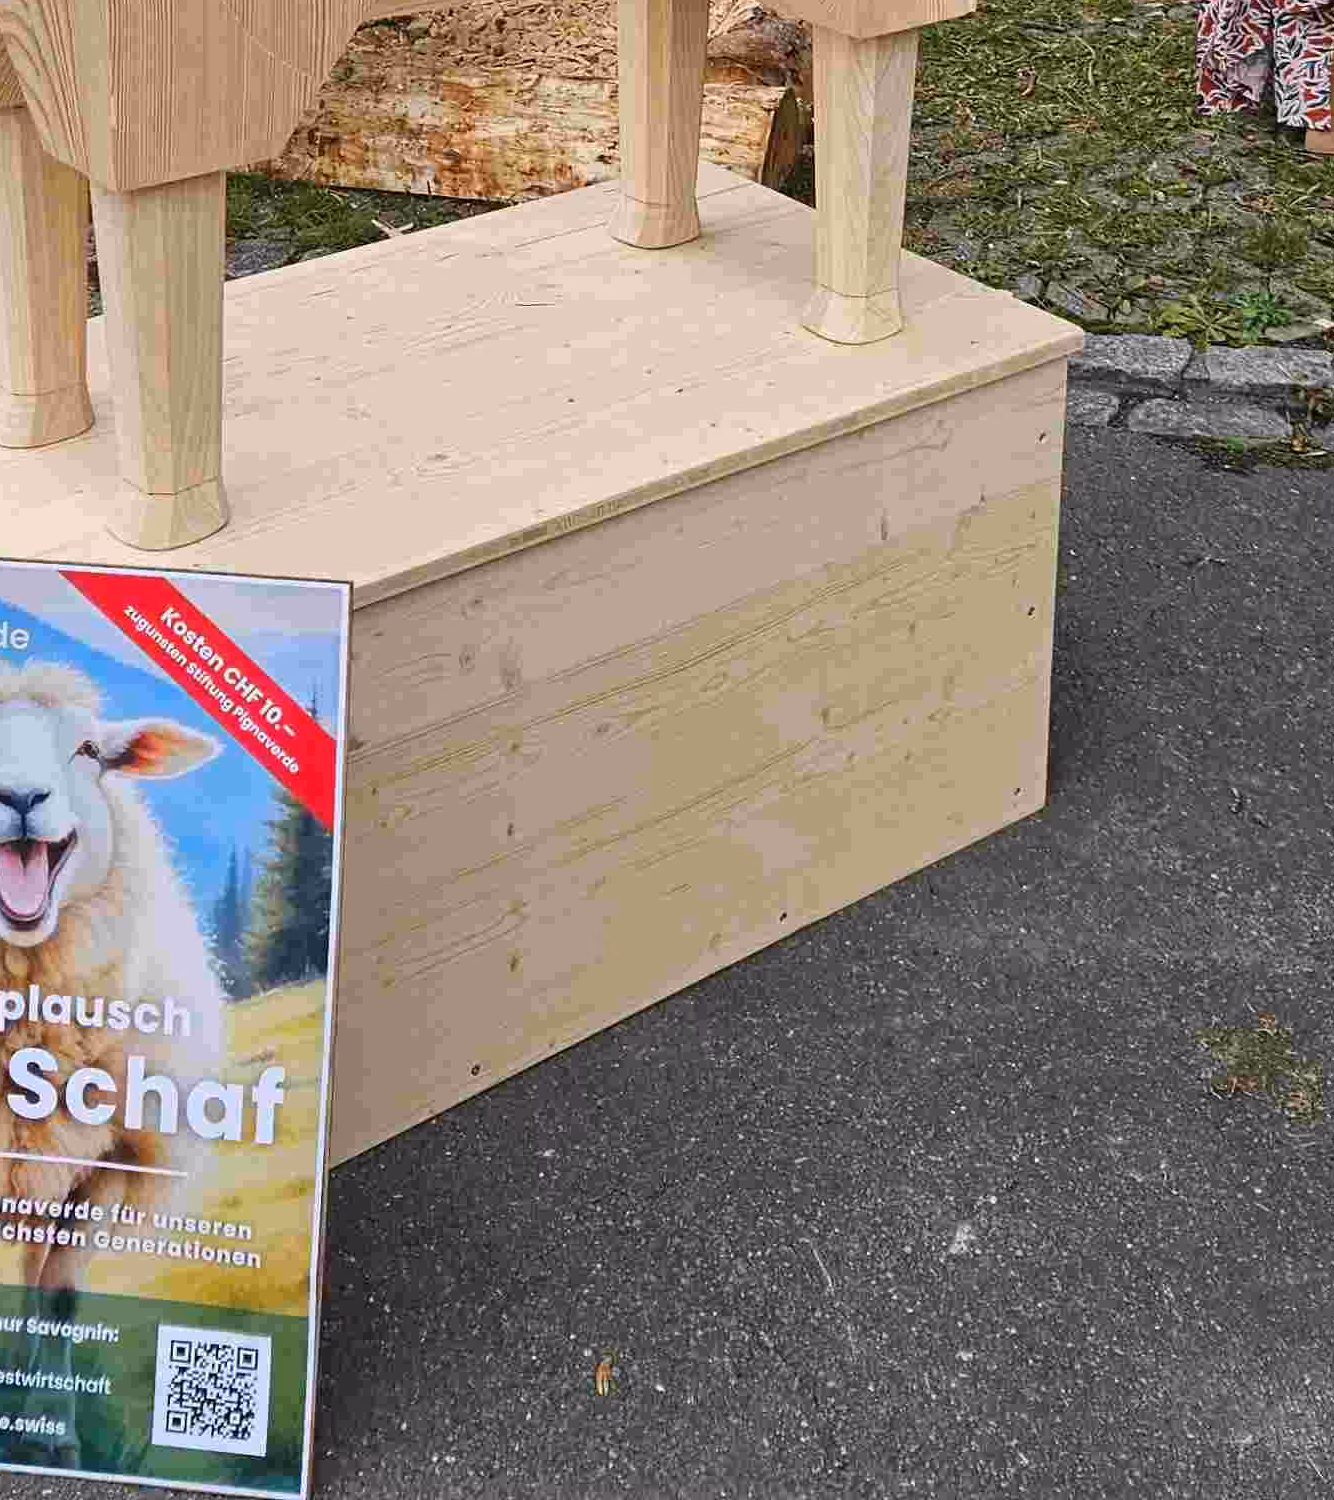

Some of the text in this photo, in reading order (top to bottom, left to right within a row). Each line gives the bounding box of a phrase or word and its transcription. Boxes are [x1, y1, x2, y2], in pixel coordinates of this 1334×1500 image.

[160, 606, 226, 672] Kosten
[223, 667, 264, 703] CHF
[123, 605, 300, 773] zugunsten Stiftung Pignaverde
[110, 1202, 147, 1227] für
[153, 1213, 253, 1240] unseren
[93, 1230, 262, 1269] Generationen
[25, 1316, 120, 1344] Savognin:
